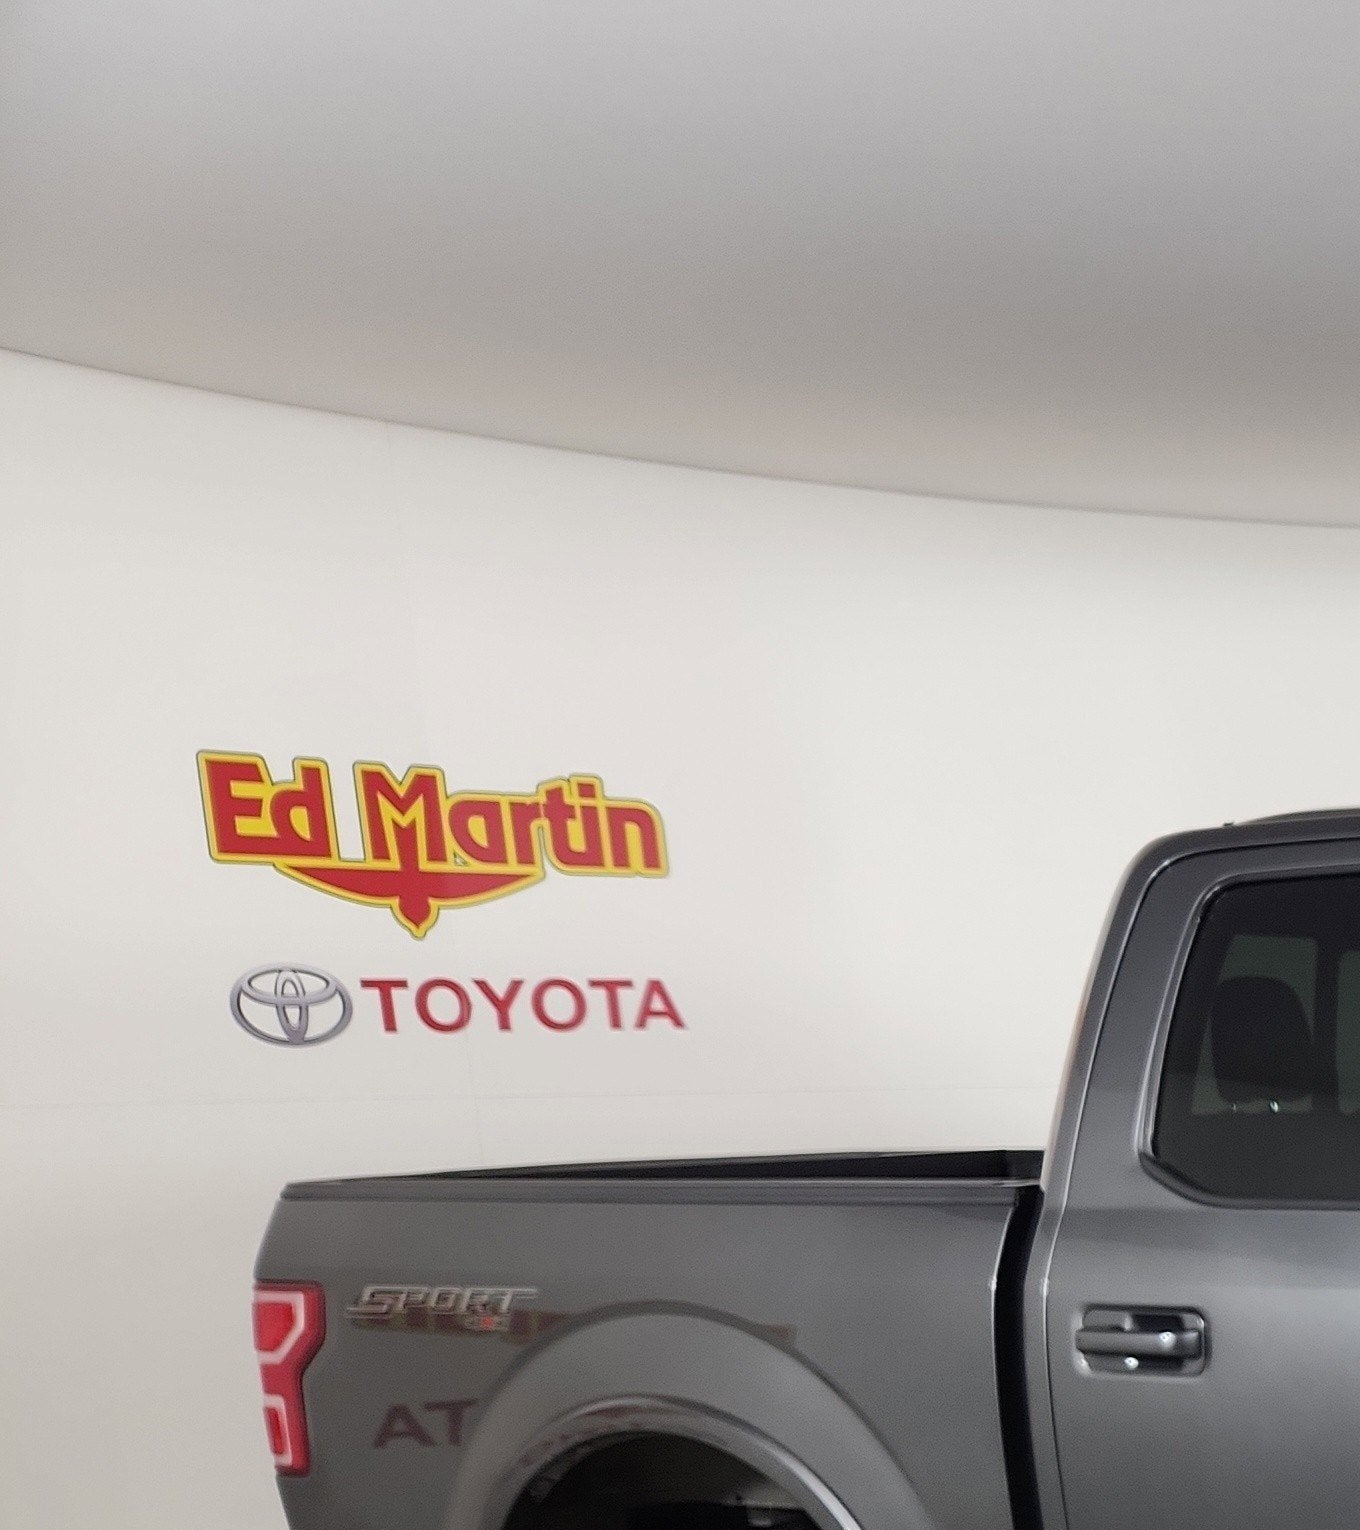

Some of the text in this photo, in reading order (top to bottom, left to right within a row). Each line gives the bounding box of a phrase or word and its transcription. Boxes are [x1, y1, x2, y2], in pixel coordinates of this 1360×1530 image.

[201, 755, 661, 872] Ed Martin
[361, 978, 686, 1034] TOYOTA
[347, 1286, 538, 1319] SPORT
